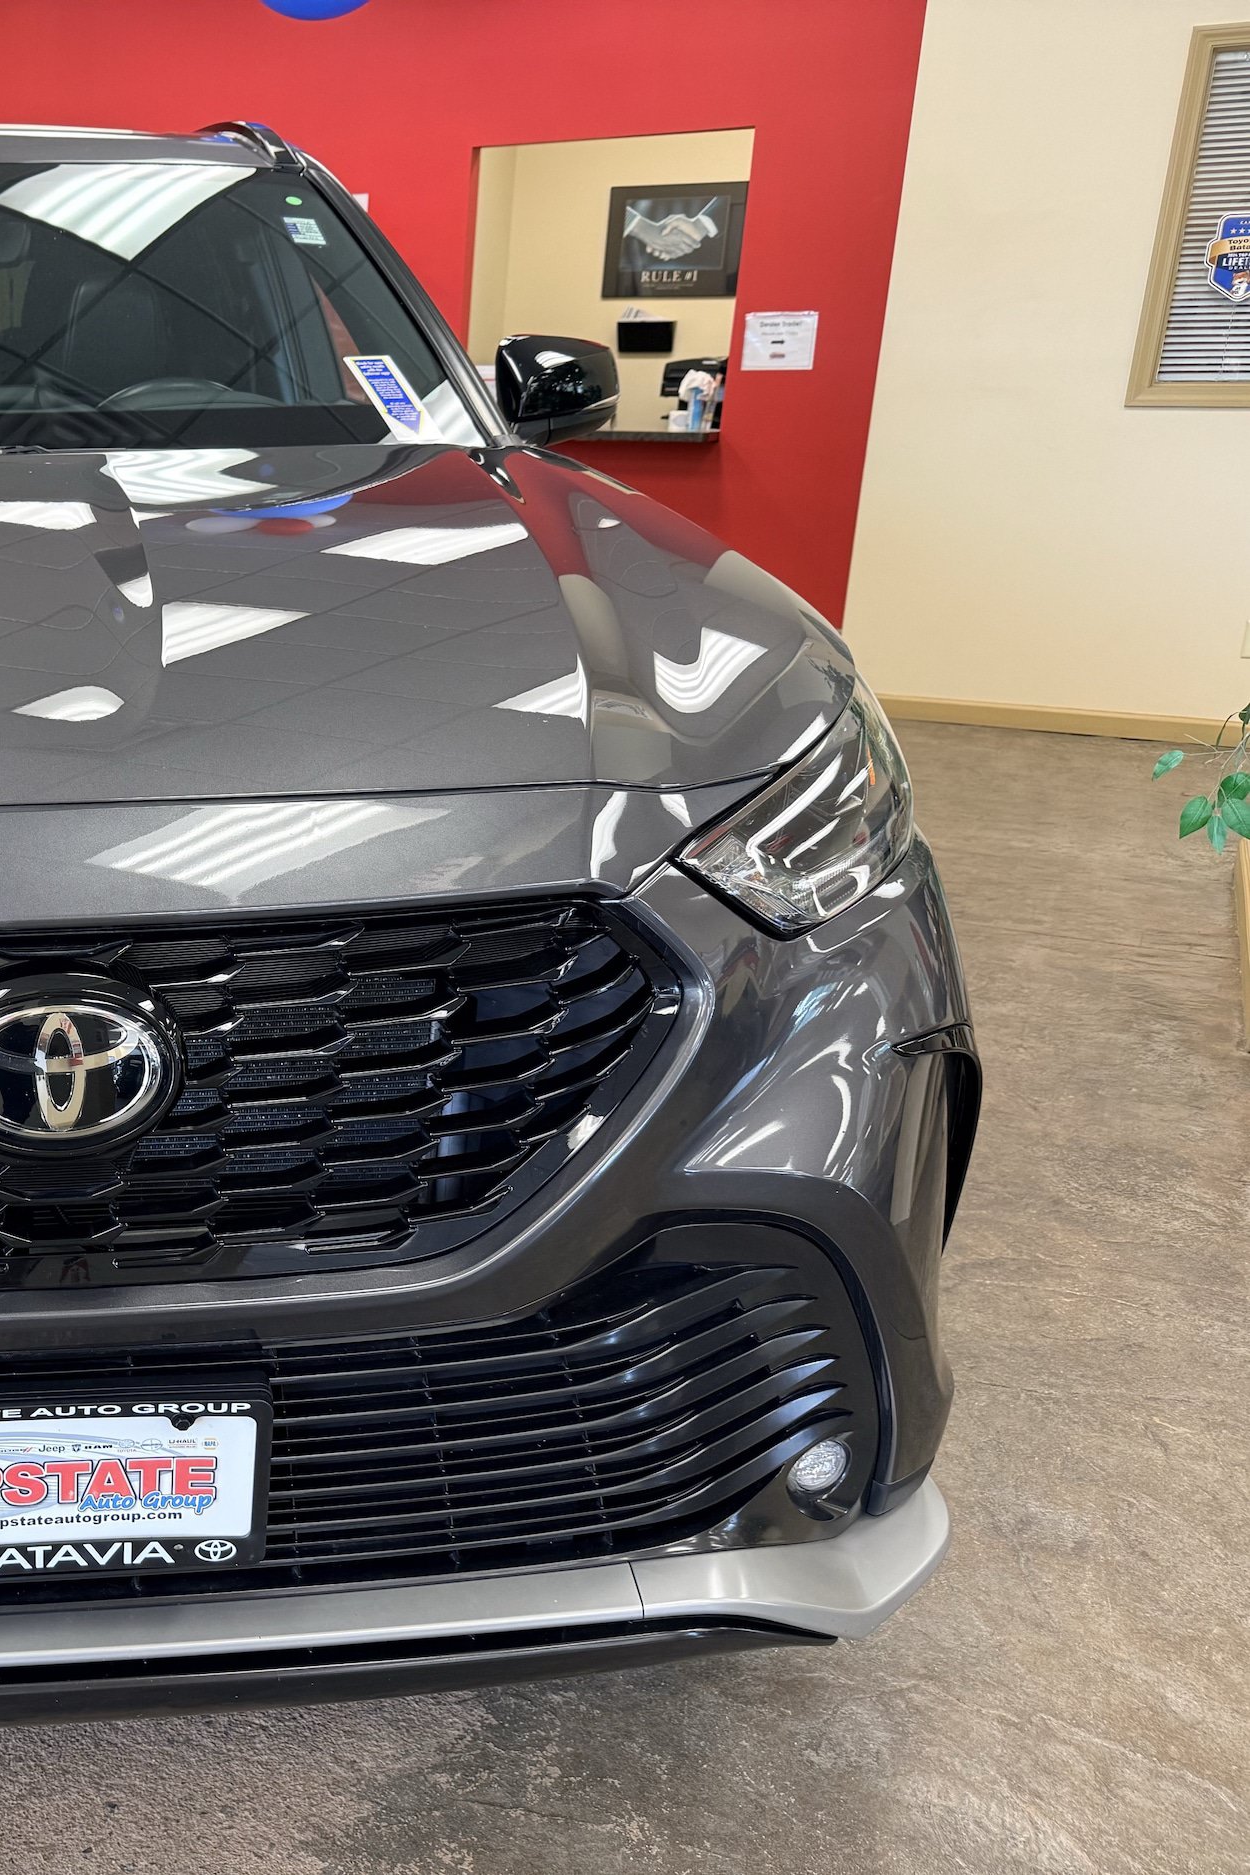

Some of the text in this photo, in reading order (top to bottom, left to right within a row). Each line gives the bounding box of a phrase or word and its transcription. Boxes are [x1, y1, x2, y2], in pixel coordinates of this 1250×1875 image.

[640, 270, 681, 283] RULE
[29, 1403, 122, 1418] AUTO
[130, 1401, 252, 1415] GROUP
[38, 1444, 66, 1454] Jeep
[78, 1491, 215, 1515] Auto Group
